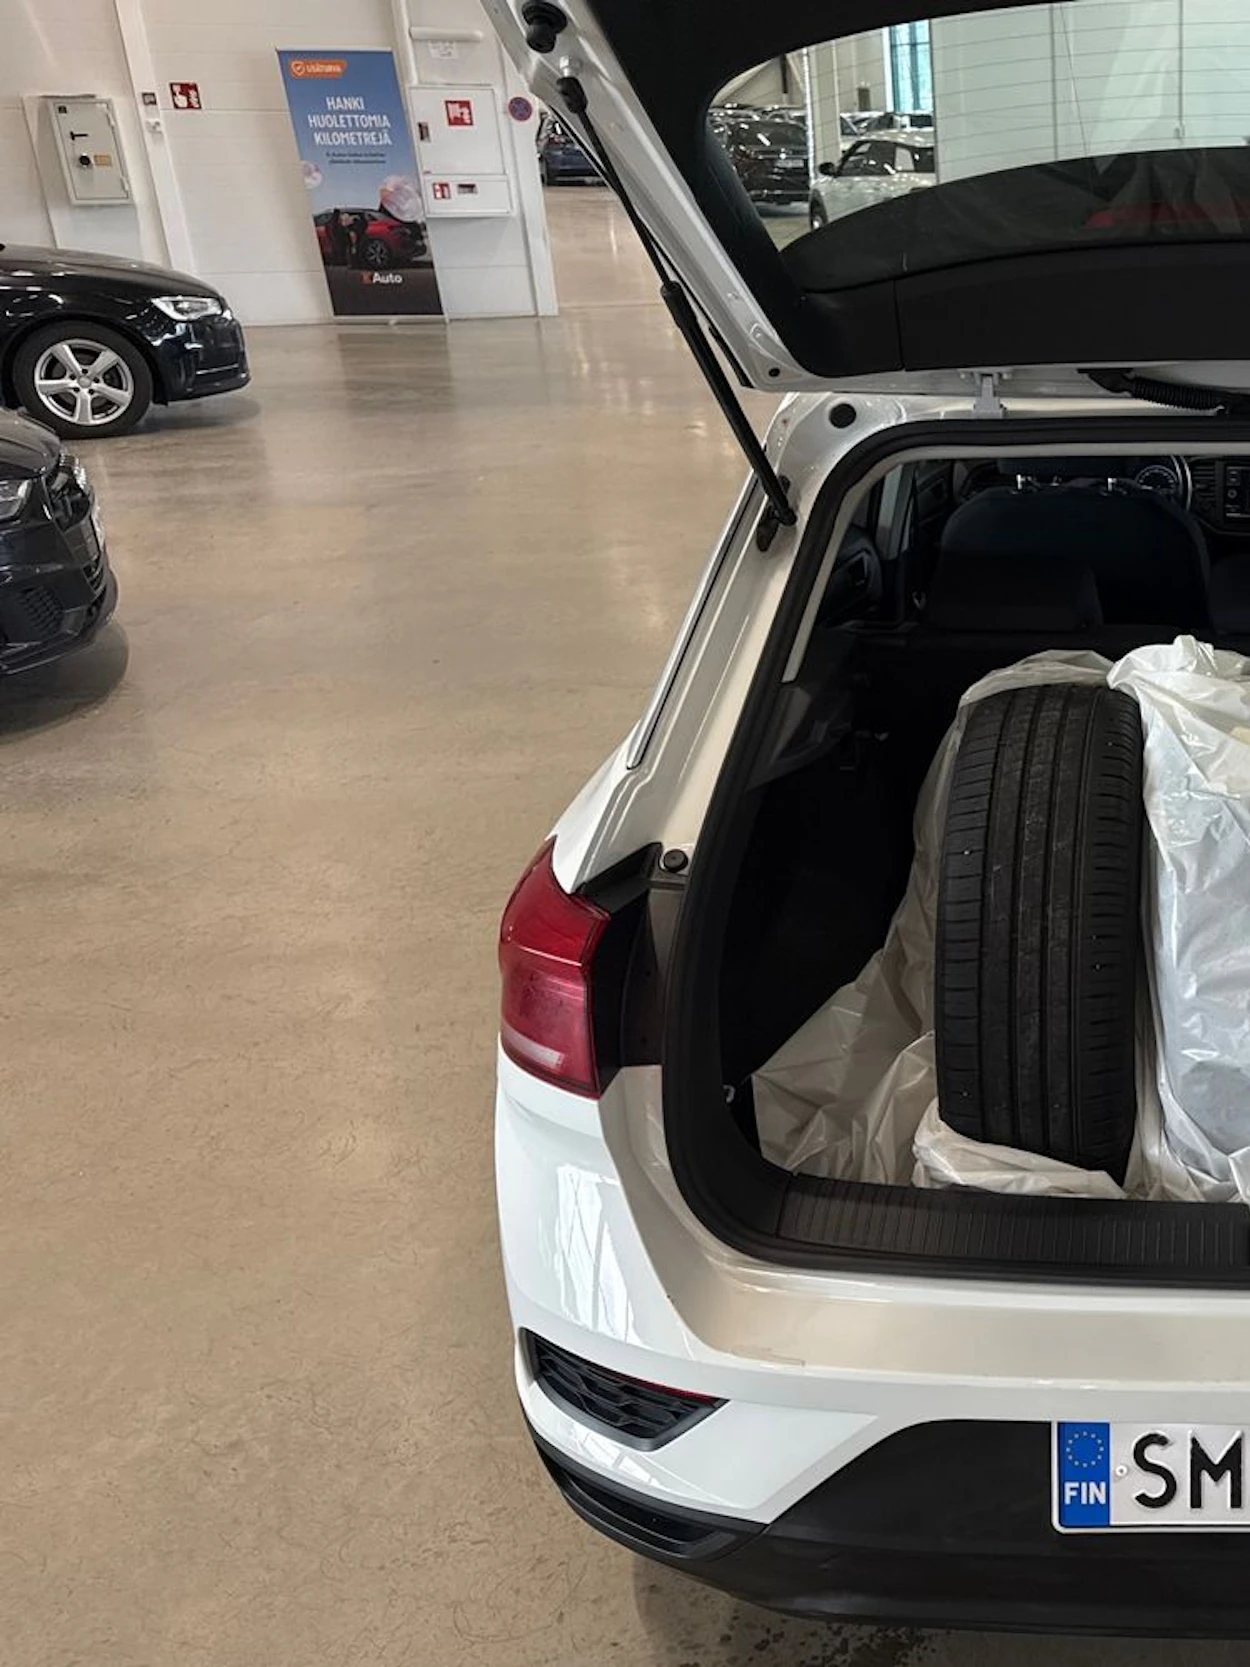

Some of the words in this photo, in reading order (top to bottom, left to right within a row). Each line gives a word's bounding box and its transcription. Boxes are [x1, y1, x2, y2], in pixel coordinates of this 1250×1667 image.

[325, 96, 365, 110] HANKI
[307, 114, 391, 128] HUOLETTOMIA
[313, 129, 393, 145] KILOMETREJÄ
[1064, 1481, 1107, 1505] FIN
